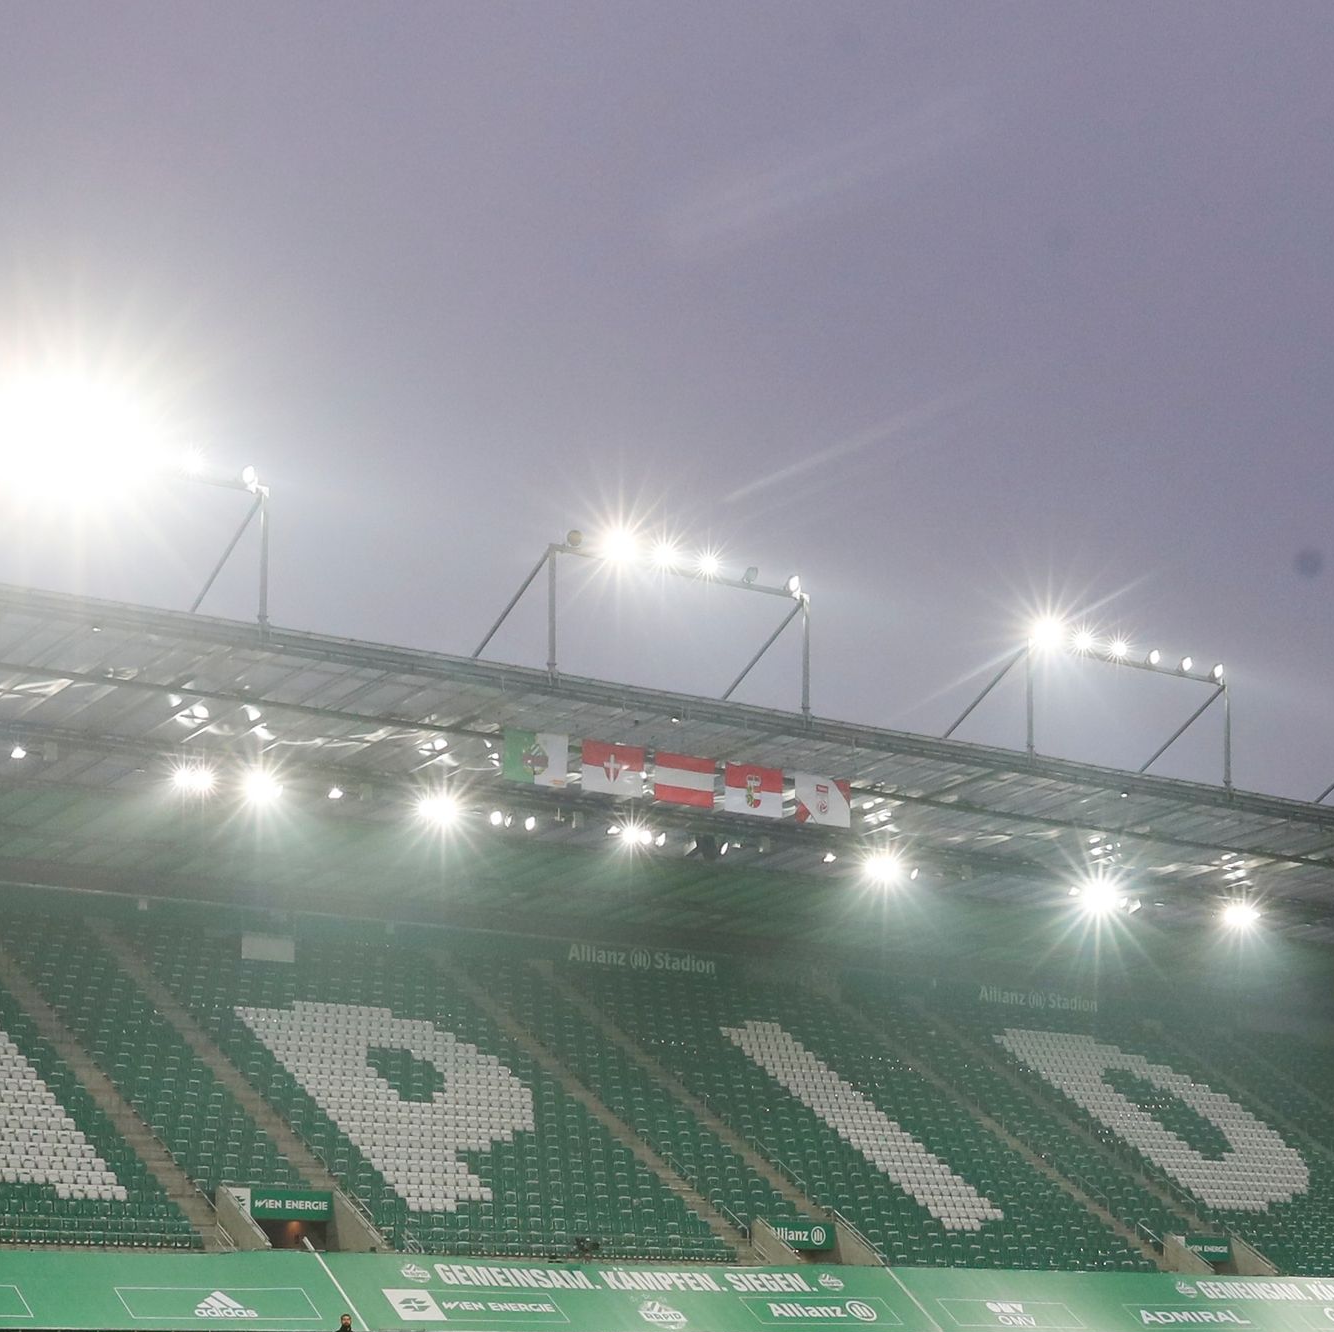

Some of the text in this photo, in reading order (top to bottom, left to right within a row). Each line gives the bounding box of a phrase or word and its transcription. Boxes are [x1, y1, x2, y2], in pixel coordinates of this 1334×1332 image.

[569, 943, 715, 974] Allianz Stadion
[978, 985, 1098, 1013] Allianz Stadion
[253, 1199, 329, 1211] WIEN ENERGIE
[772, 1226, 809, 1241] llianz
[434, 1264, 818, 1293] GEMEINSAM. KÄMPFEN. SIEGEN.
[1195, 1280, 1312, 1302] GEMEINSAM.
[194, 1307, 258, 1319] adidas
[441, 1299, 556, 1314] WIEN ENERGIE
[766, 1301, 848, 1319] Allianz
[1138, 1309, 1253, 1326] ADMIRAL
